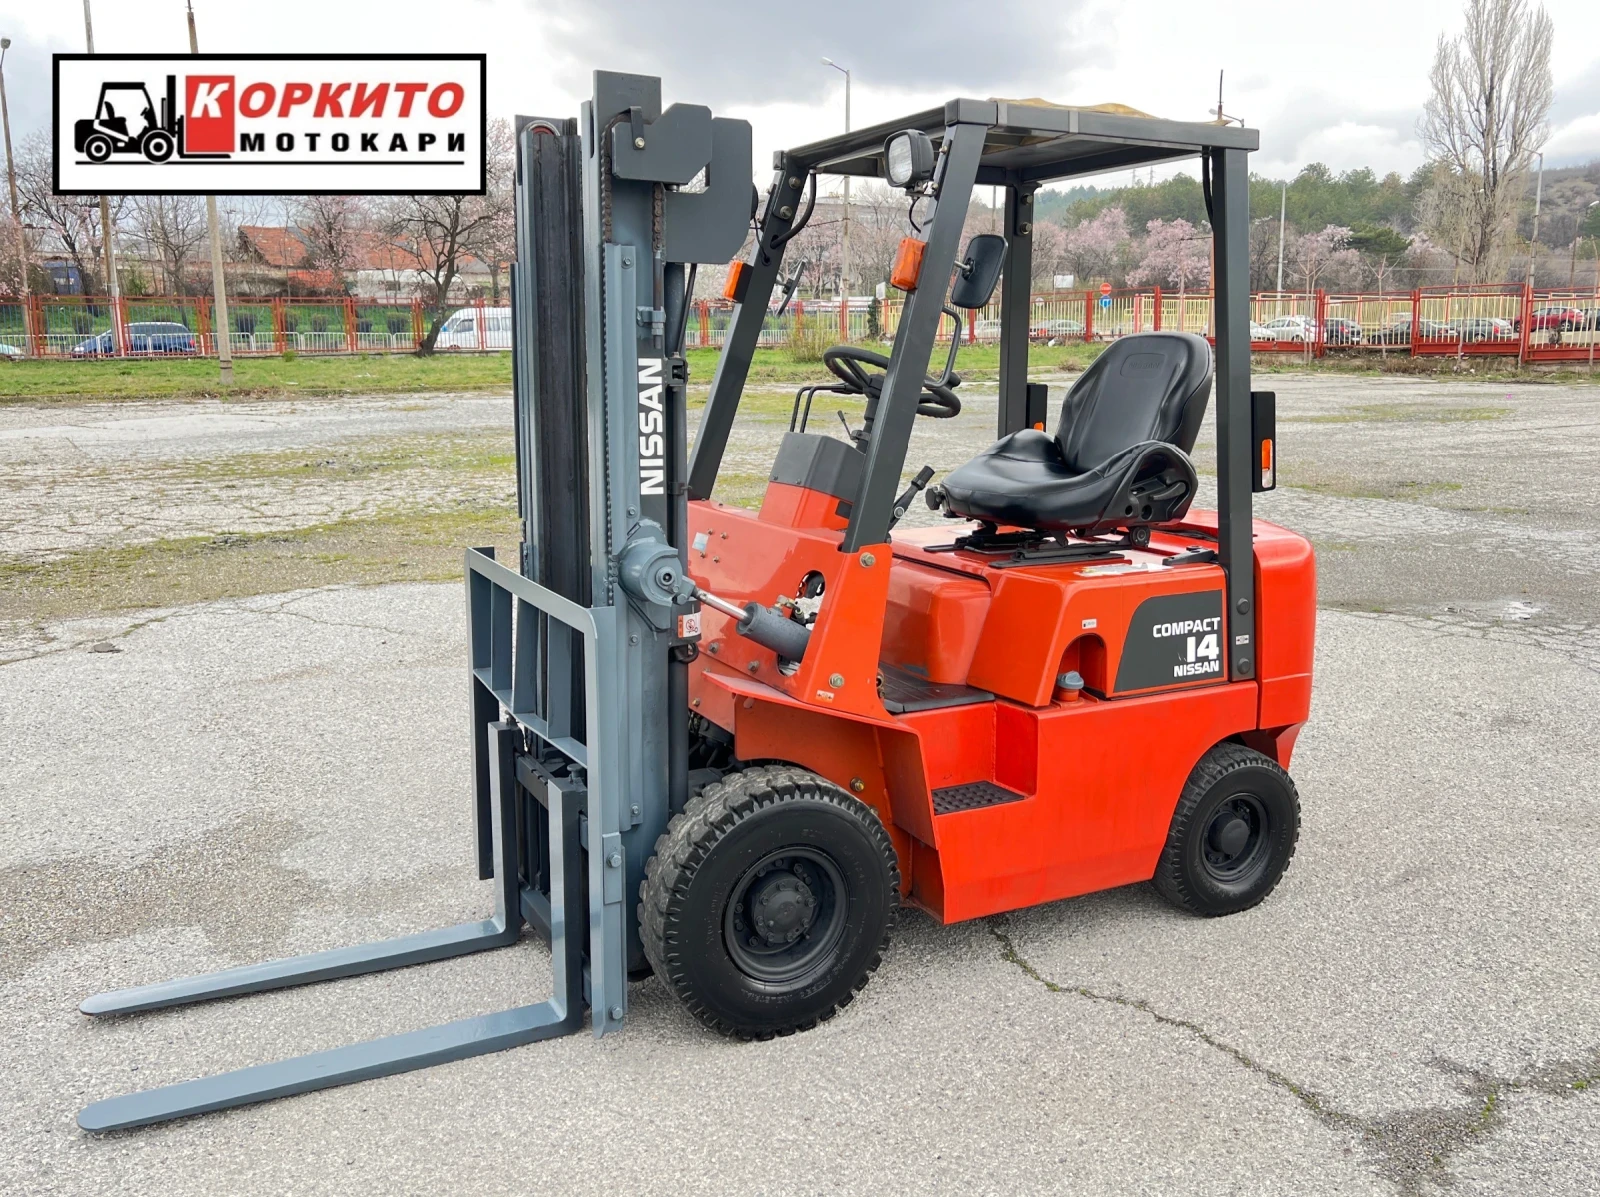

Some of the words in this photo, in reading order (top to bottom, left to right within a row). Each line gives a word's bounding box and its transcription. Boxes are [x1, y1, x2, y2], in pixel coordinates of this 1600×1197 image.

[638, 358, 664, 495] NISSAN
[1152, 616, 1221, 638] COMPACT
[1186, 633, 1220, 663] 14
[1173, 660, 1220, 678] NISSAN
